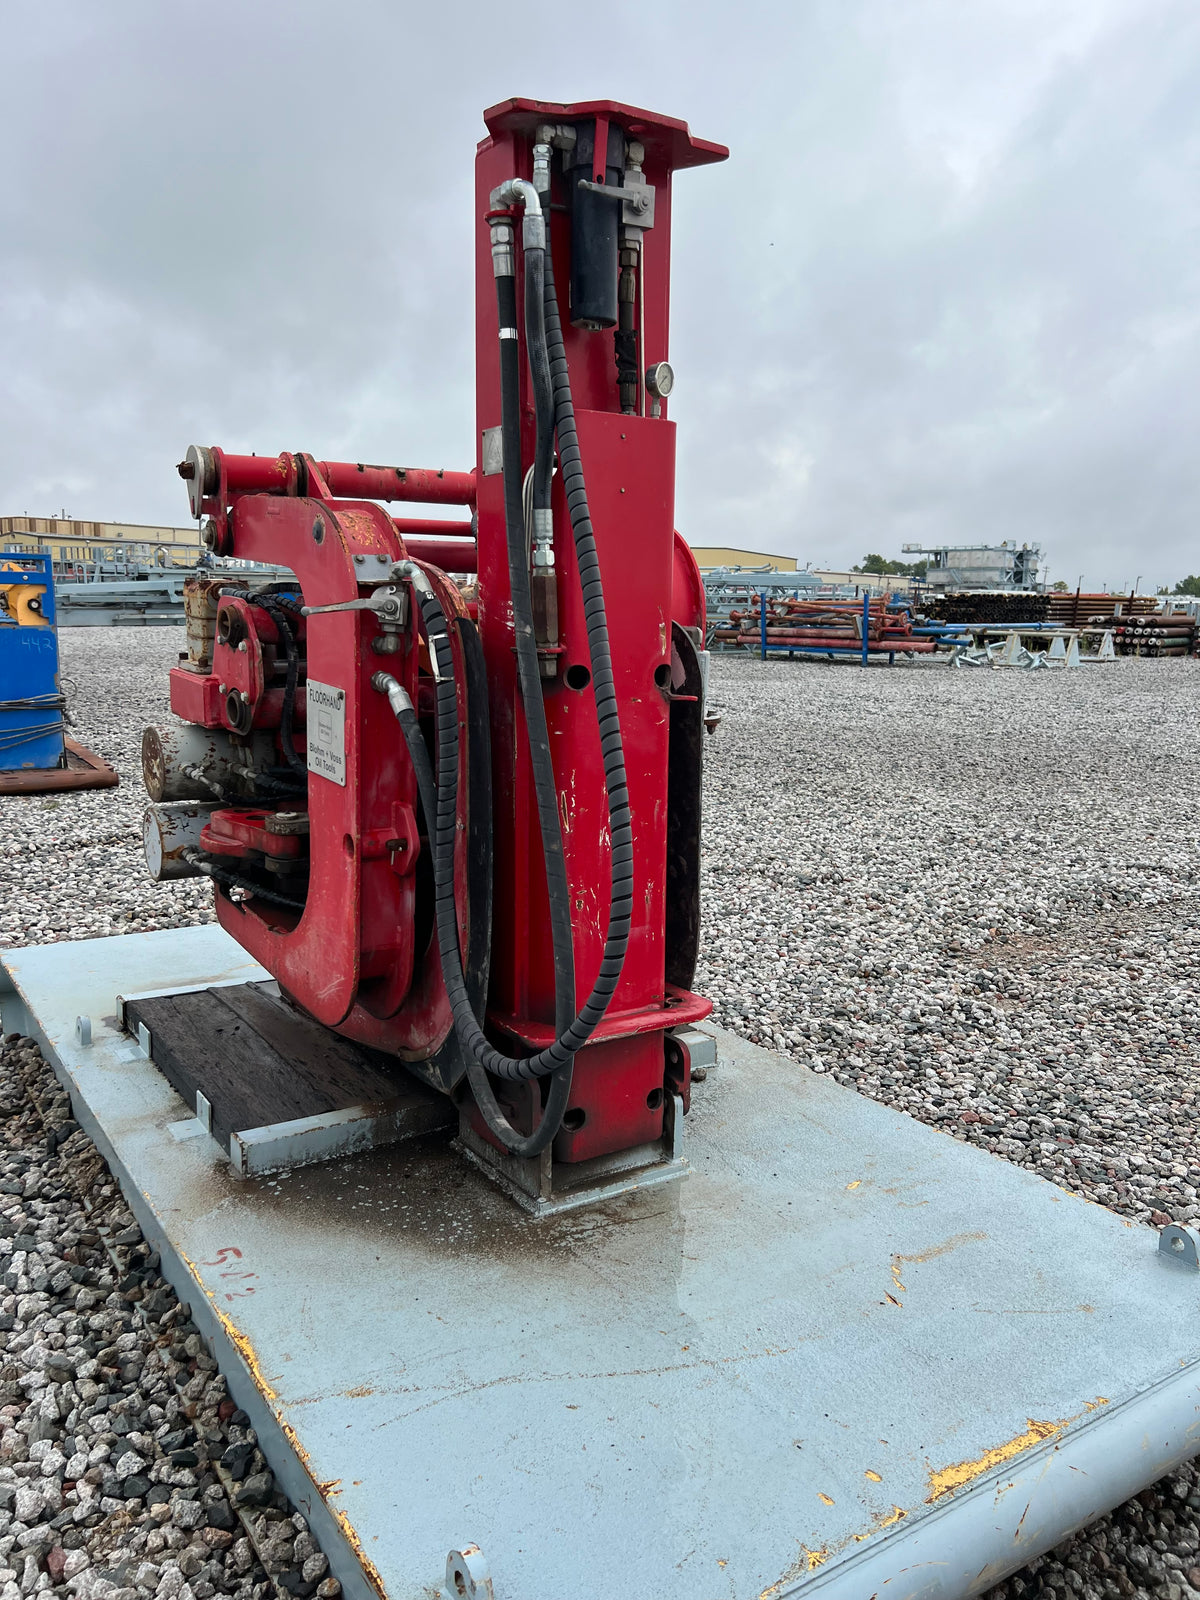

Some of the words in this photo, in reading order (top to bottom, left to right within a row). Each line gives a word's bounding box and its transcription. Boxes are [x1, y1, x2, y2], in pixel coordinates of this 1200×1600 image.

[21, 635, 54, 654] 442
[309, 688, 342, 711] FLOORHAND
[309, 742, 325, 757] Blohm
[329, 751, 342, 765] Voss
[323, 759, 336, 774] Tools
